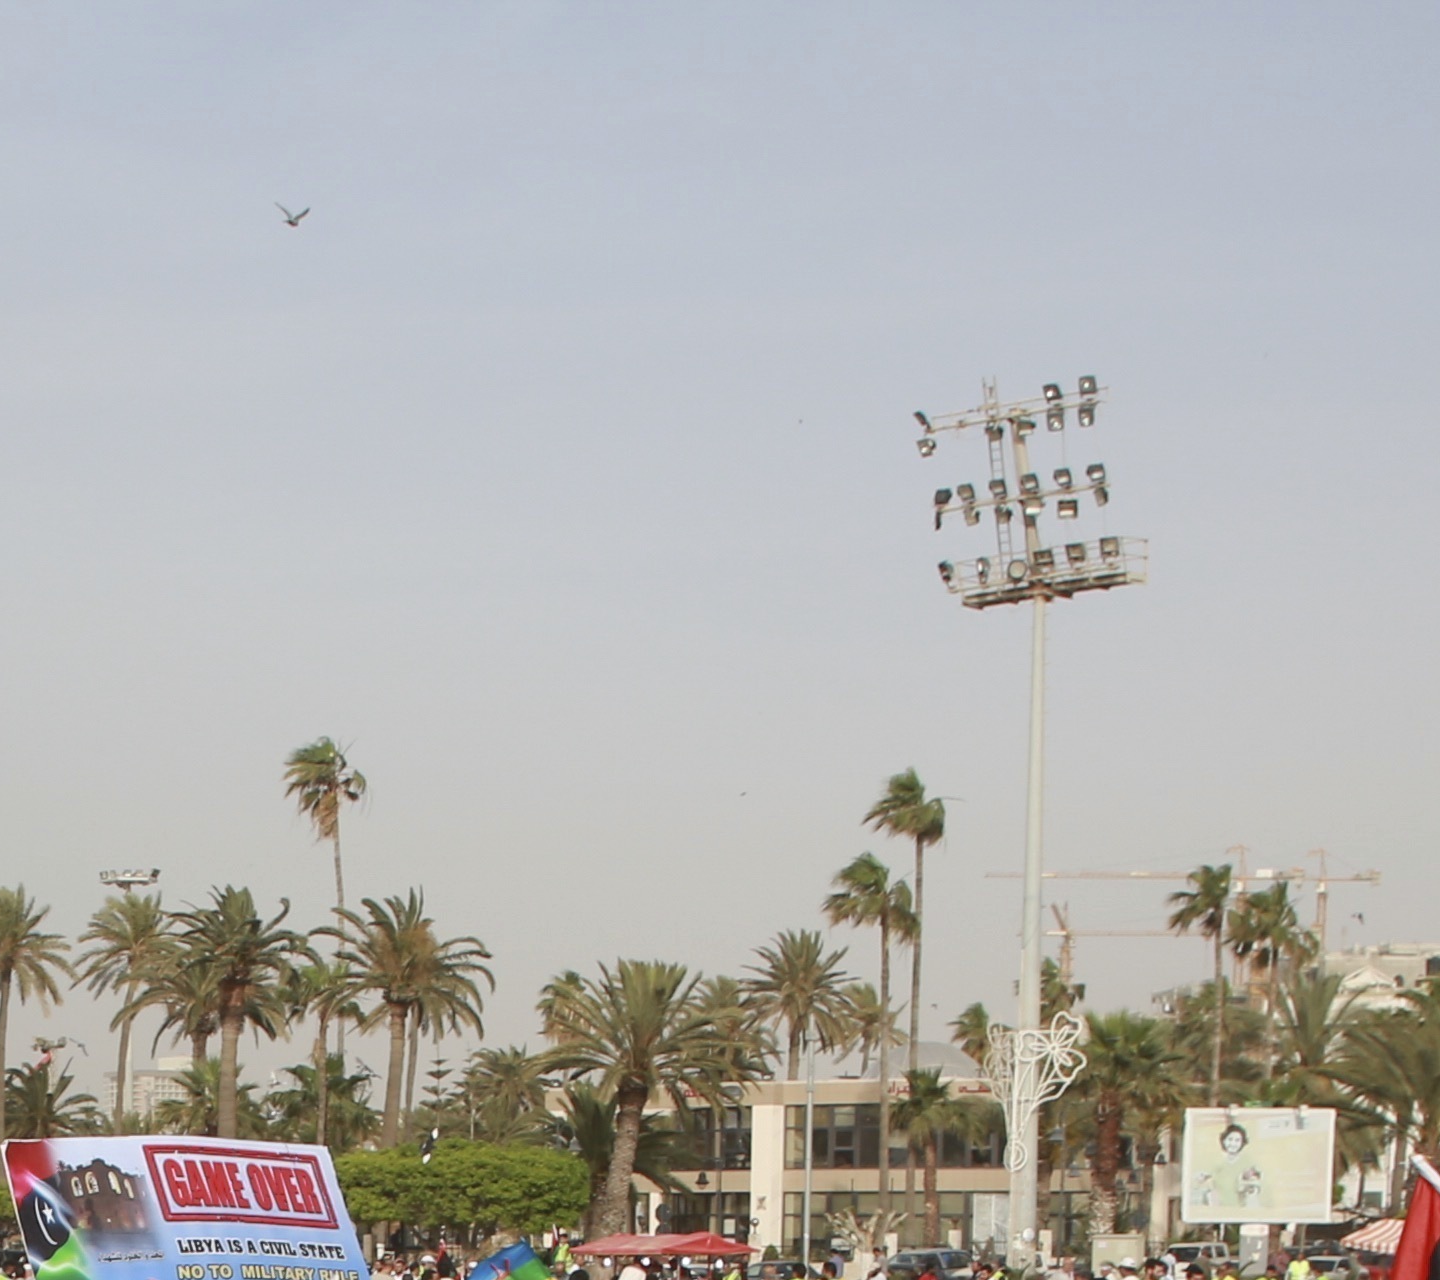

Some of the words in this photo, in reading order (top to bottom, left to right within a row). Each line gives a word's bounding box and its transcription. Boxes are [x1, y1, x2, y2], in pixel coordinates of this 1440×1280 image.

[163, 1157, 251, 1210] GAME
[247, 1163, 324, 1215] OVER
[176, 1237, 224, 1256] LIBYA
[227, 1238, 245, 1255] IS
[246, 1239, 260, 1256] A
[260, 1240, 298, 1258] CIVIL
[300, 1242, 347, 1261] STATE
[176, 1263, 206, 1280] NO
[209, 1263, 234, 1280] TO
